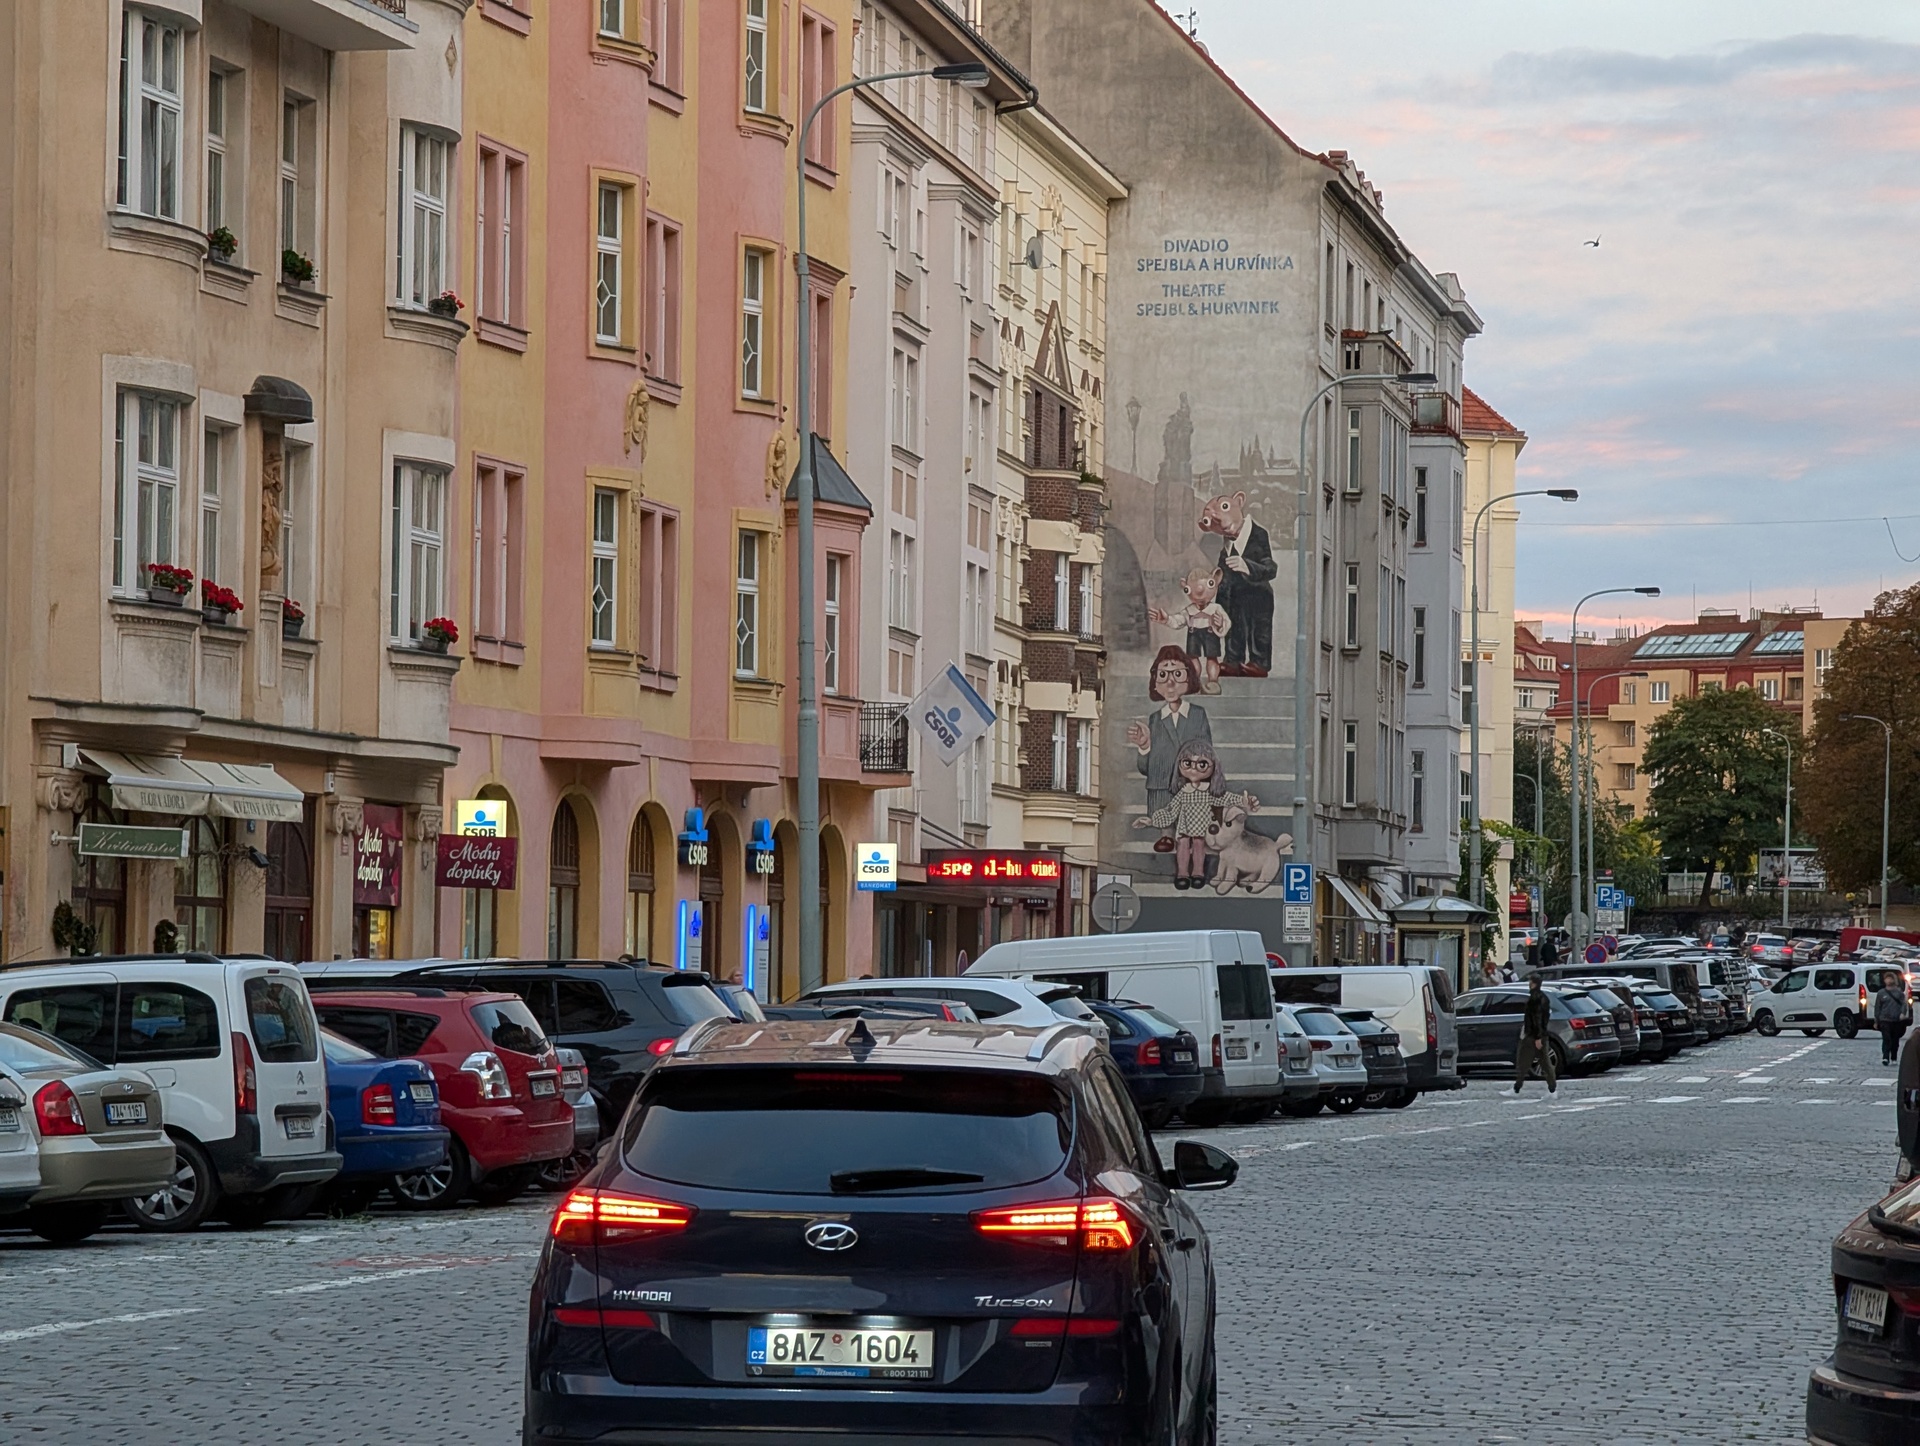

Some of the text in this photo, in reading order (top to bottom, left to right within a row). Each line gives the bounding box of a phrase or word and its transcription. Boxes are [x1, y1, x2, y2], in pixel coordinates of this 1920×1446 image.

[1137, 253, 1294, 272] SPEJBLA A HURVÍNKA
[1162, 283, 1226, 297] THEATRE
[1136, 301, 1280, 316] SPEJBL & HURVINEK
[924, 709, 956, 749] ČSOB
[463, 827, 497, 837] ČSOB
[358, 824, 383, 857] Módní
[449, 840, 501, 863] Módní
[688, 843, 708, 866] ČSOB
[756, 851, 775, 874] ČSOB
[862, 864, 890, 874] ČSOB
[1289, 868, 1306, 891] P
[1722, 875, 1731, 889] P
[1600, 888, 1610, 902] P
[1613, 893, 1622, 904] P
[612, 1290, 672, 1302] HYUNDAI
[773, 1333, 919, 1363] 8AZ 1604
[751, 1351, 765, 1360] CZ
[907, 1370, 918, 1378] 121
[919, 1370, 929, 1378] 111
